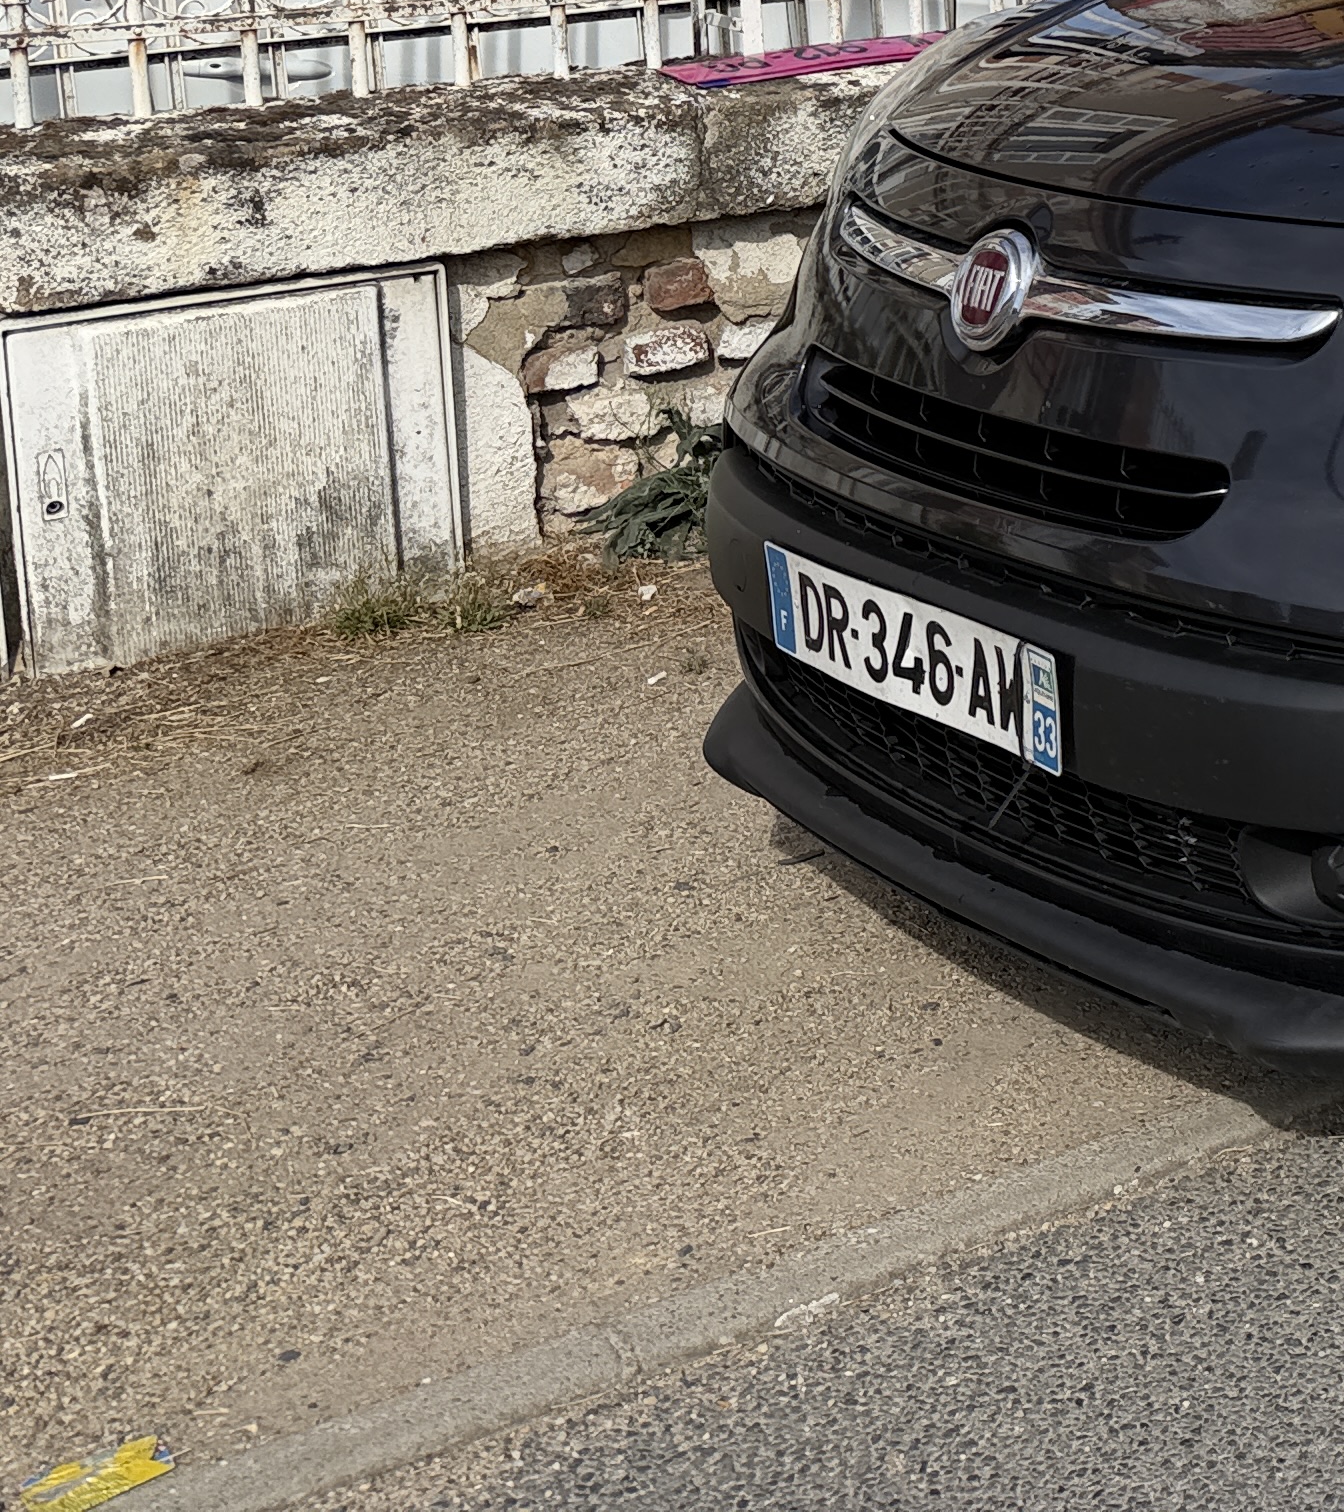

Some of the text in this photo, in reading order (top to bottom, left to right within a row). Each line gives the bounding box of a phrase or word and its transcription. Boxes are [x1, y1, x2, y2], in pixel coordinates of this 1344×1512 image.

[963, 263, 1006, 312] FIAT
[780, 609, 788, 631] F
[1034, 710, 1057, 759] 33
